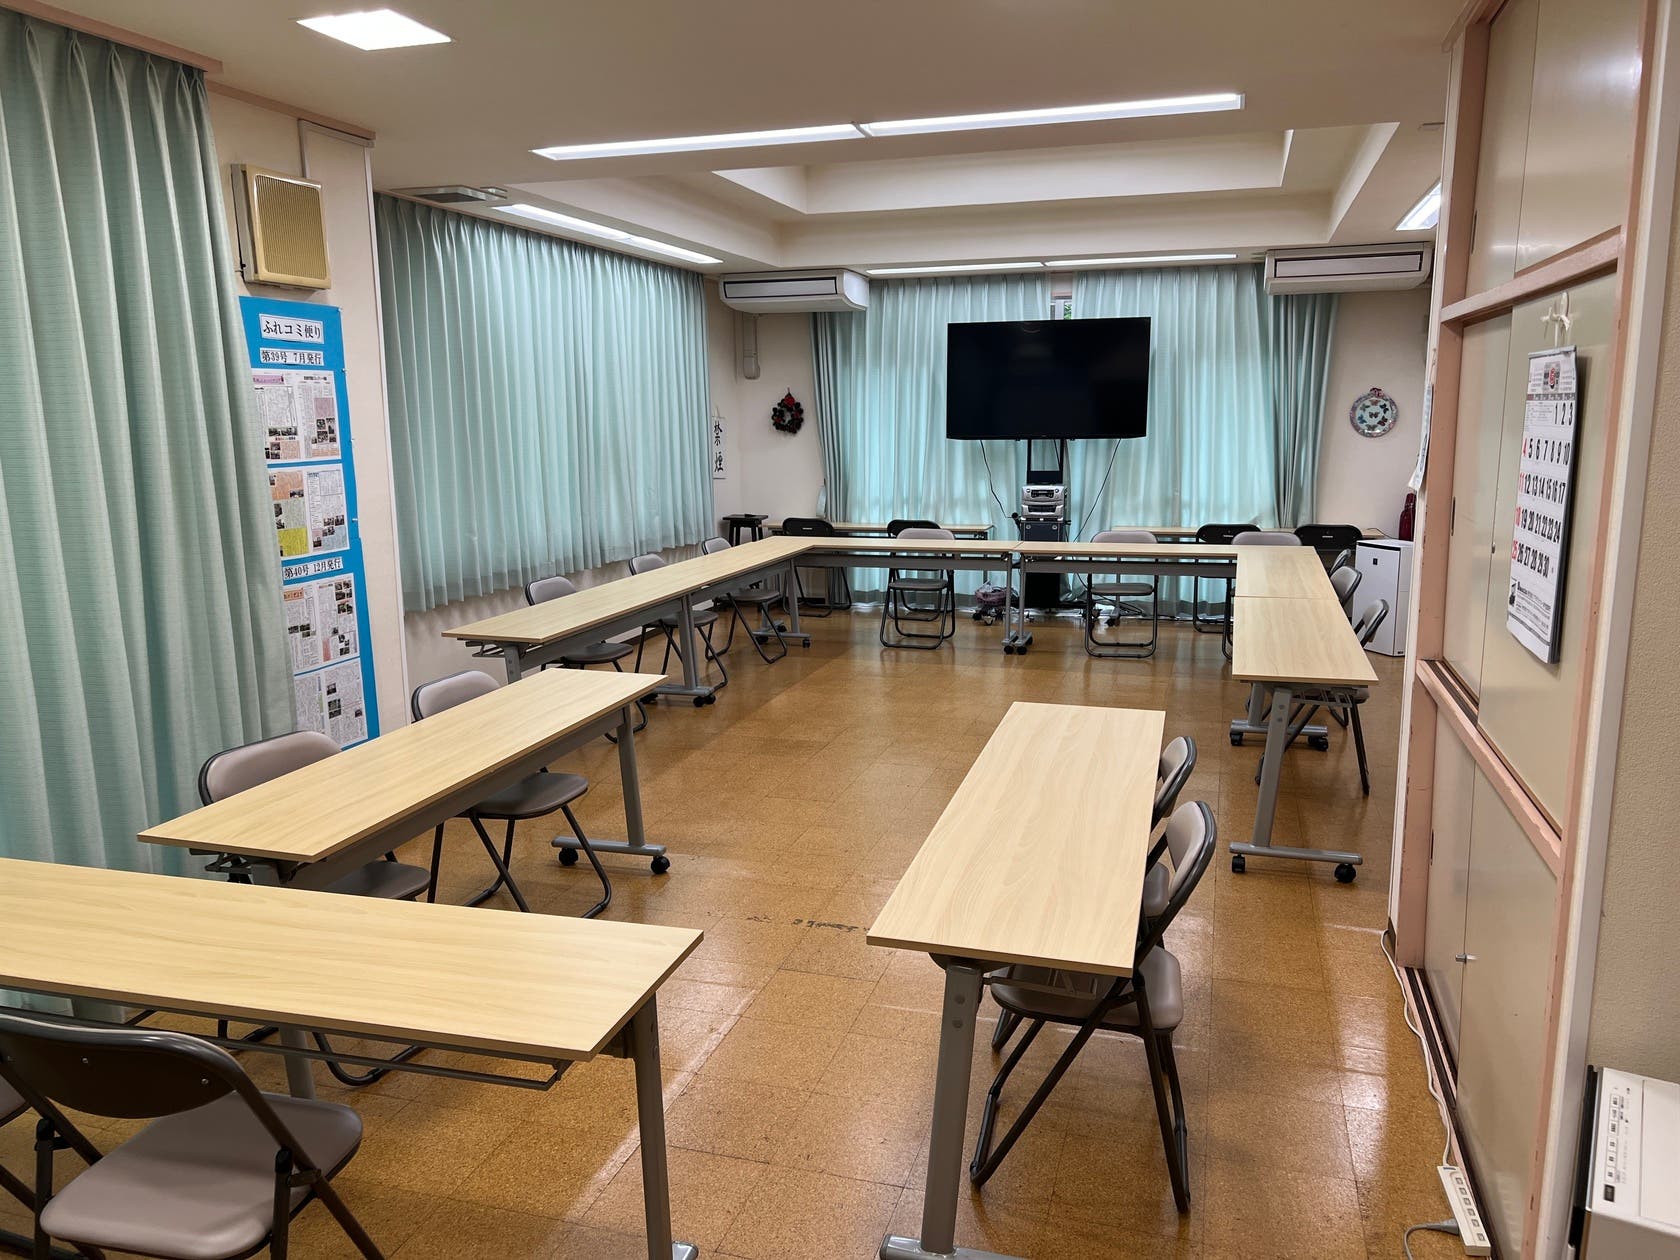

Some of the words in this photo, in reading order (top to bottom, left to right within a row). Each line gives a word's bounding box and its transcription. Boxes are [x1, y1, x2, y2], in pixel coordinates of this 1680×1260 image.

[264, 320, 320, 339] ふれコミ便り
[262, 350, 287, 363] 第39号
[294, 353, 321, 364] 7月発行
[1555, 402, 1558, 424] 1
[1561, 402, 1566, 425] 2
[1568, 402, 1573, 426] 3
[1523, 438, 1527, 457] 4
[1528, 438, 1533, 459] 5
[1536, 439, 1540, 460] 6
[1543, 440, 1548, 461] 7
[1551, 440, 1555, 463] 8
[1557, 441, 1562, 464] 9
[1564, 442, 1570, 465] 10
[1519, 473, 1525, 493] 11
[1525, 474, 1531, 494] 12
[1532, 475, 1538, 496] 13
[1539, 477, 1545, 498] 14
[1546, 479, 1552, 500] 15
[1552, 480, 1558, 502] 16
[1559, 482, 1566, 504] 17
[1521, 508, 1527, 529] 19
[1528, 511, 1534, 532] 20
[1535, 513, 1542, 534] 21
[1541, 515, 1548, 537] 22
[1547, 518, 1554, 541] 23
[1553, 520, 1561, 543] 24
[284, 563, 309, 579] 第40号
[313, 557, 340, 572] 12月発行
[1512, 540, 1518, 560] 25
[1517, 542, 1524, 564] 26
[1524, 545, 1531, 566] 27
[1530, 548, 1537, 571] 28
[1537, 552, 1543, 574] 29
[1543, 555, 1549, 578] 30
